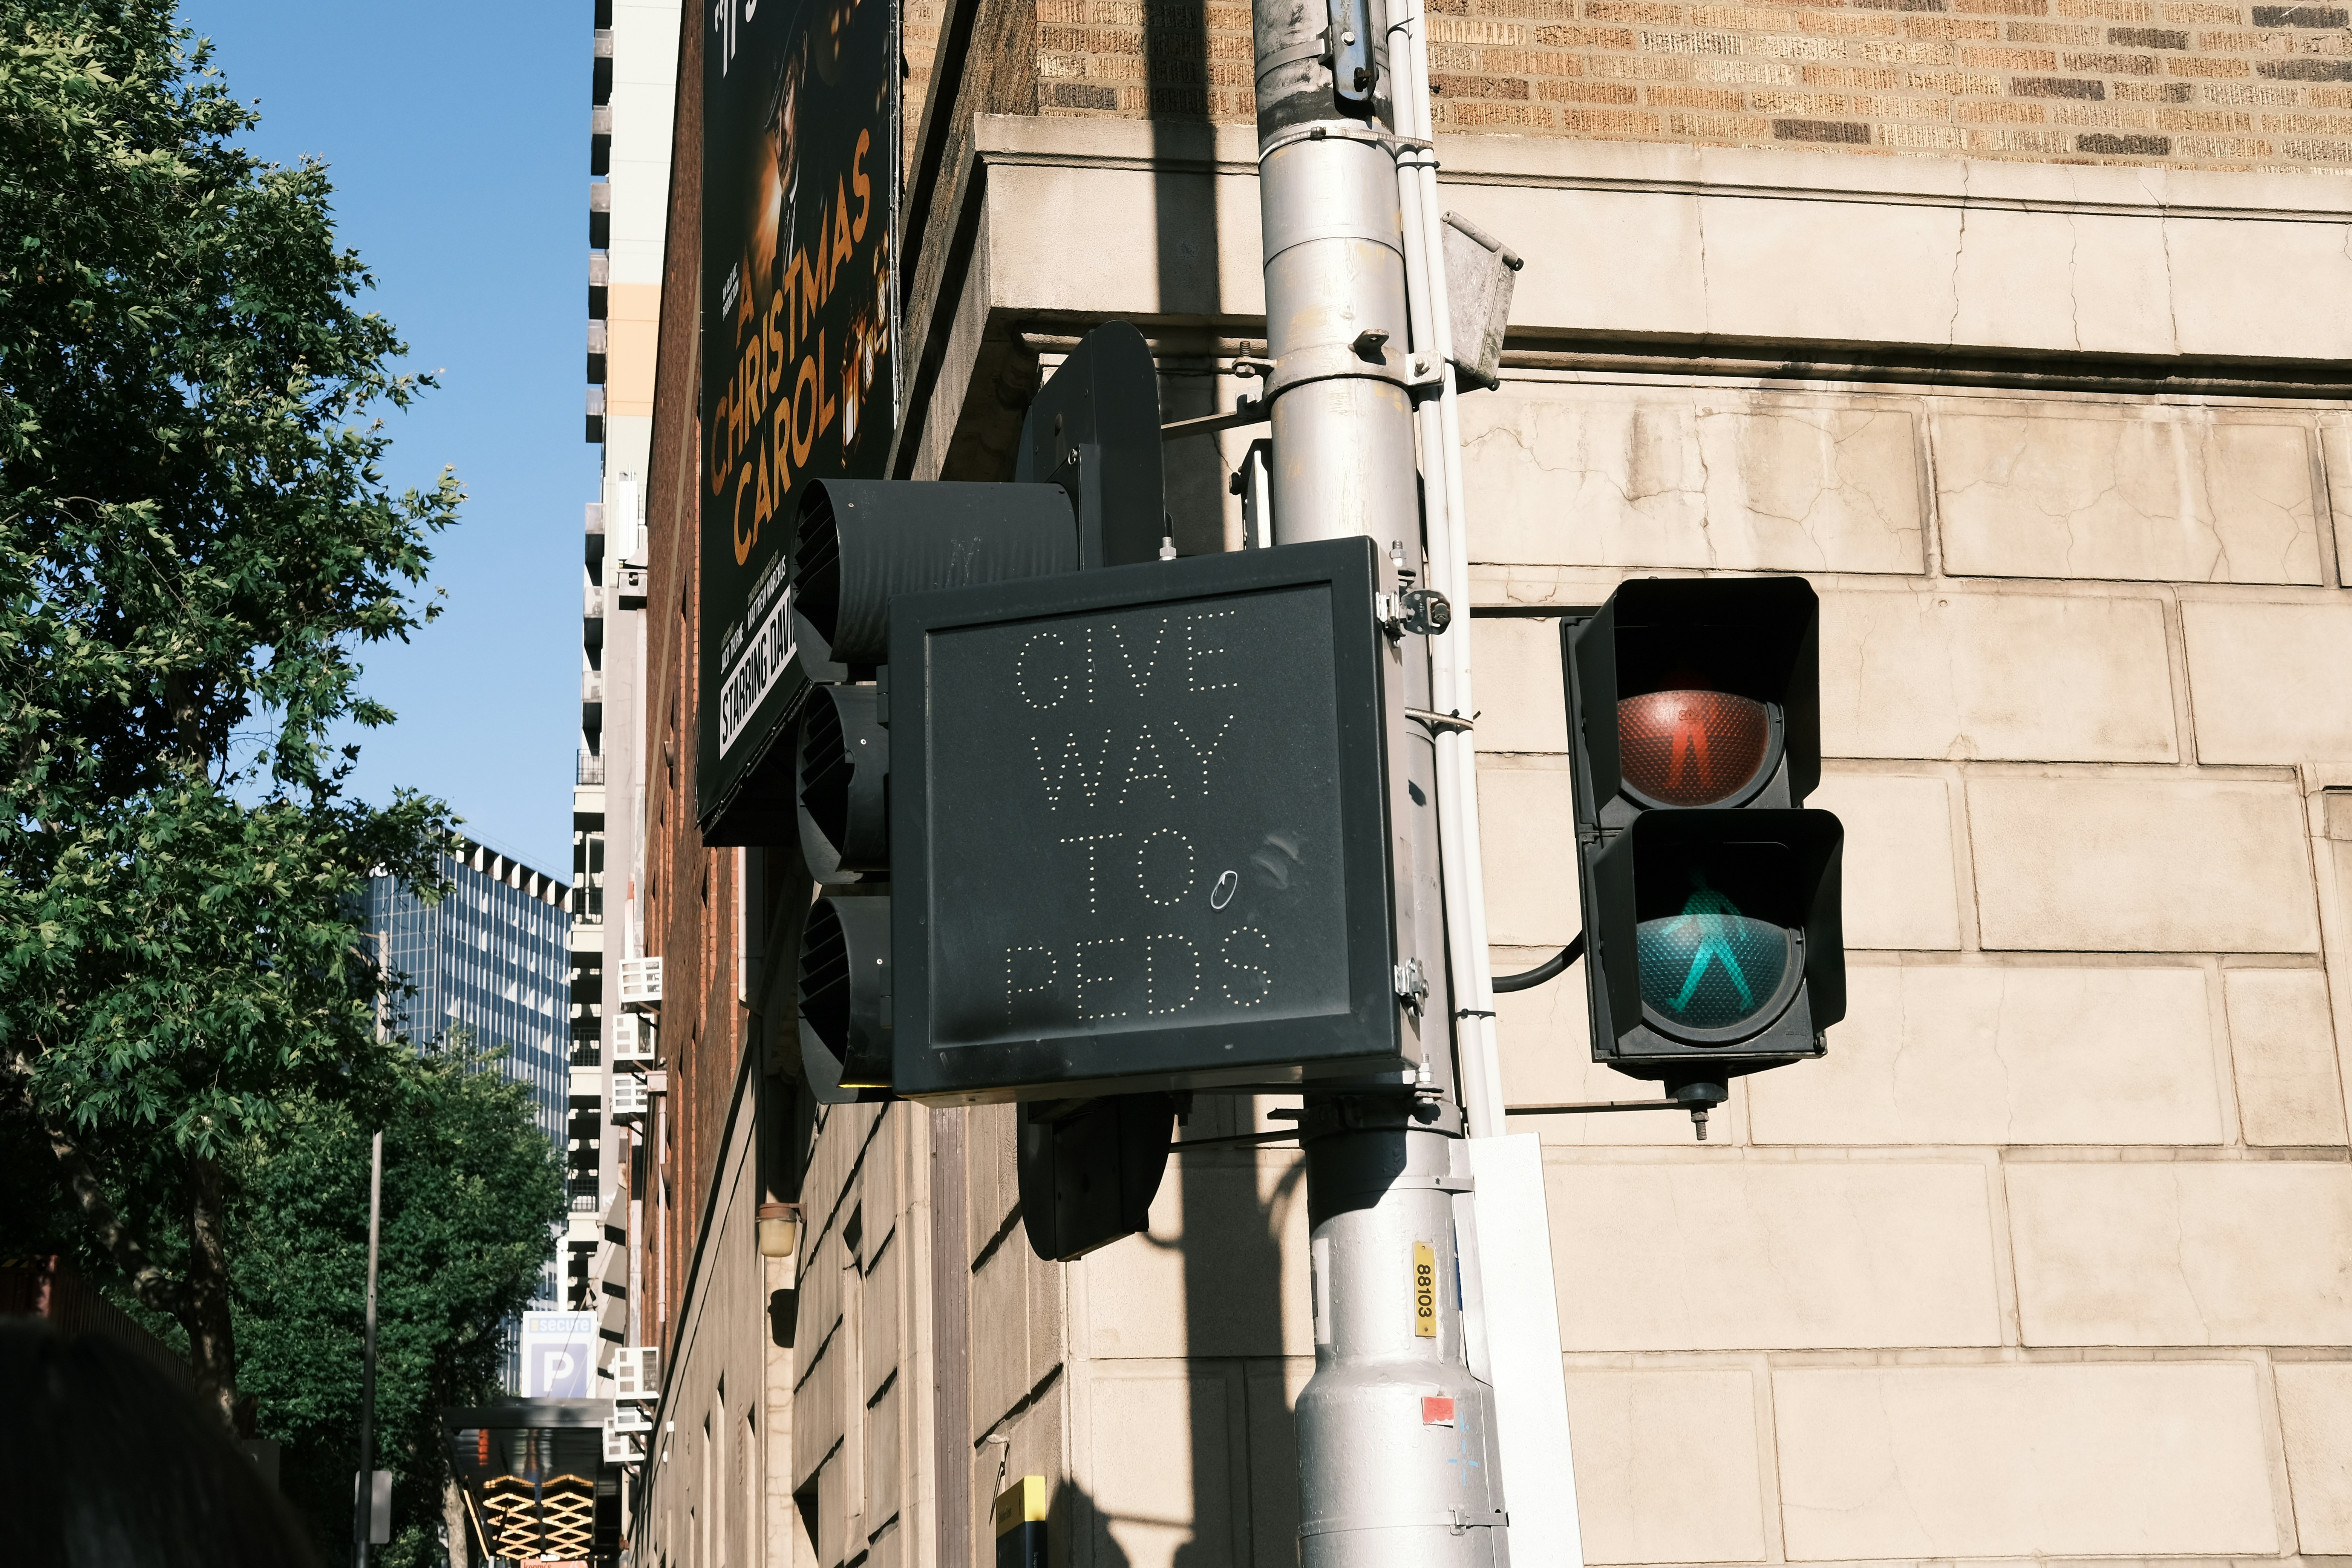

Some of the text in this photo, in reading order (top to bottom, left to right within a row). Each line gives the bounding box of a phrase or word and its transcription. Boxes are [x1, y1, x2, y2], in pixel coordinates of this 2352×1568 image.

[711, 128, 870, 496] CHRISTMAS
[723, 277, 739, 322] PRODUCTION
[736, 243, 754, 349] A
[734, 326, 835, 566] CAROL
[748, 555, 786, 631] MATTHEW WARCHUS
[721, 621, 743, 674] JACK THORNE
[722, 632, 767, 744] STARRING
[1017, 611, 1237, 709] GIVE
[1031, 715, 1234, 810] WAY
[1060, 828, 1194, 913] TO
[1007, 926, 1271, 1025] PEDS
[540, 1320, 589, 1331] secure
[1417, 1264, 1432, 1317] 88103
[544, 1352, 574, 1392] P
